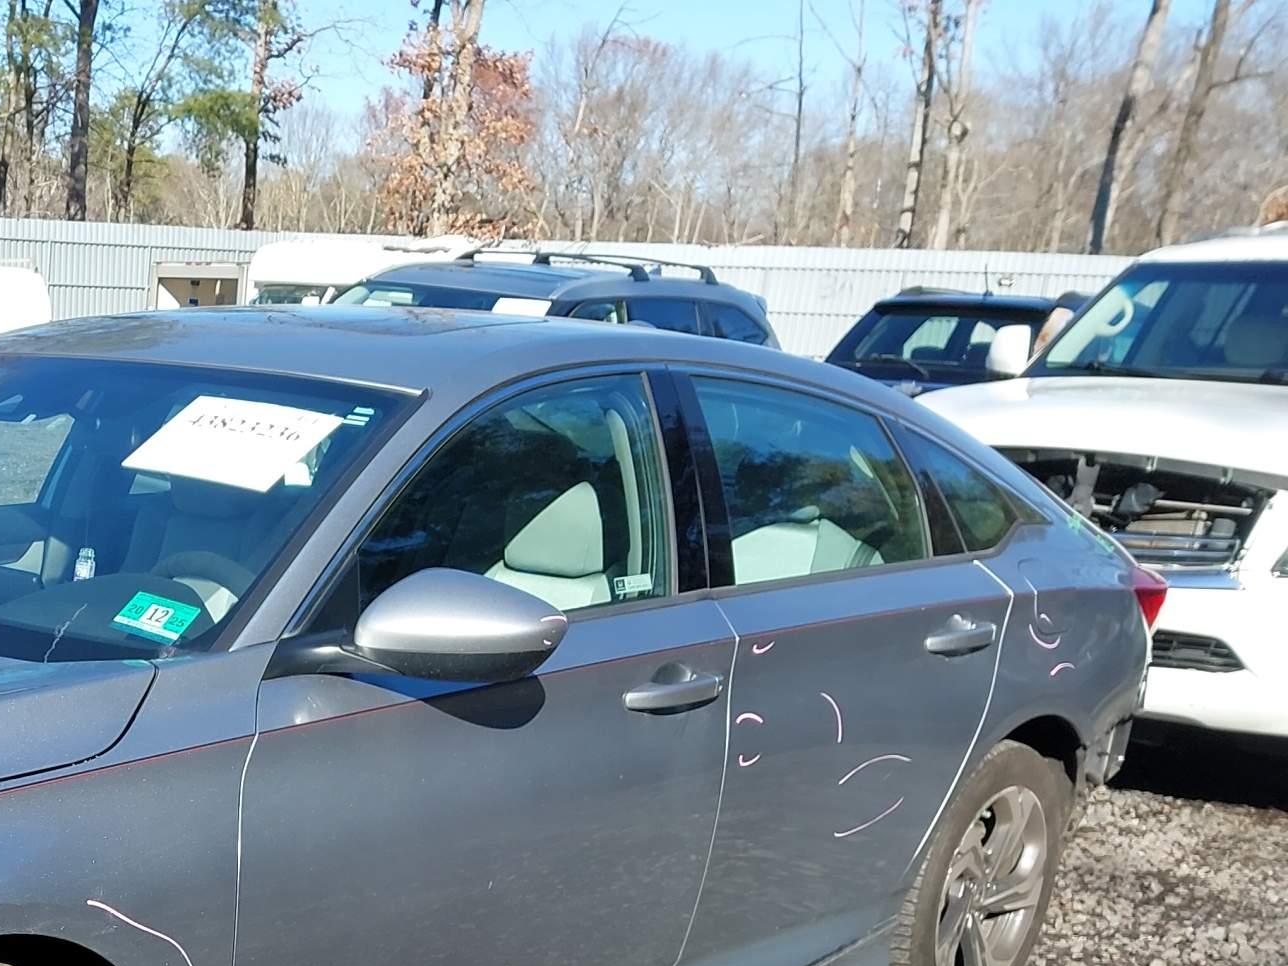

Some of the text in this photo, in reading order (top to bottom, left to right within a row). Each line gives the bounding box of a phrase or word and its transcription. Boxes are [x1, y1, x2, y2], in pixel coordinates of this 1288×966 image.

[127, 603, 145, 615] 20
[146, 607, 169, 623] 12
[169, 616, 186, 628] 25
